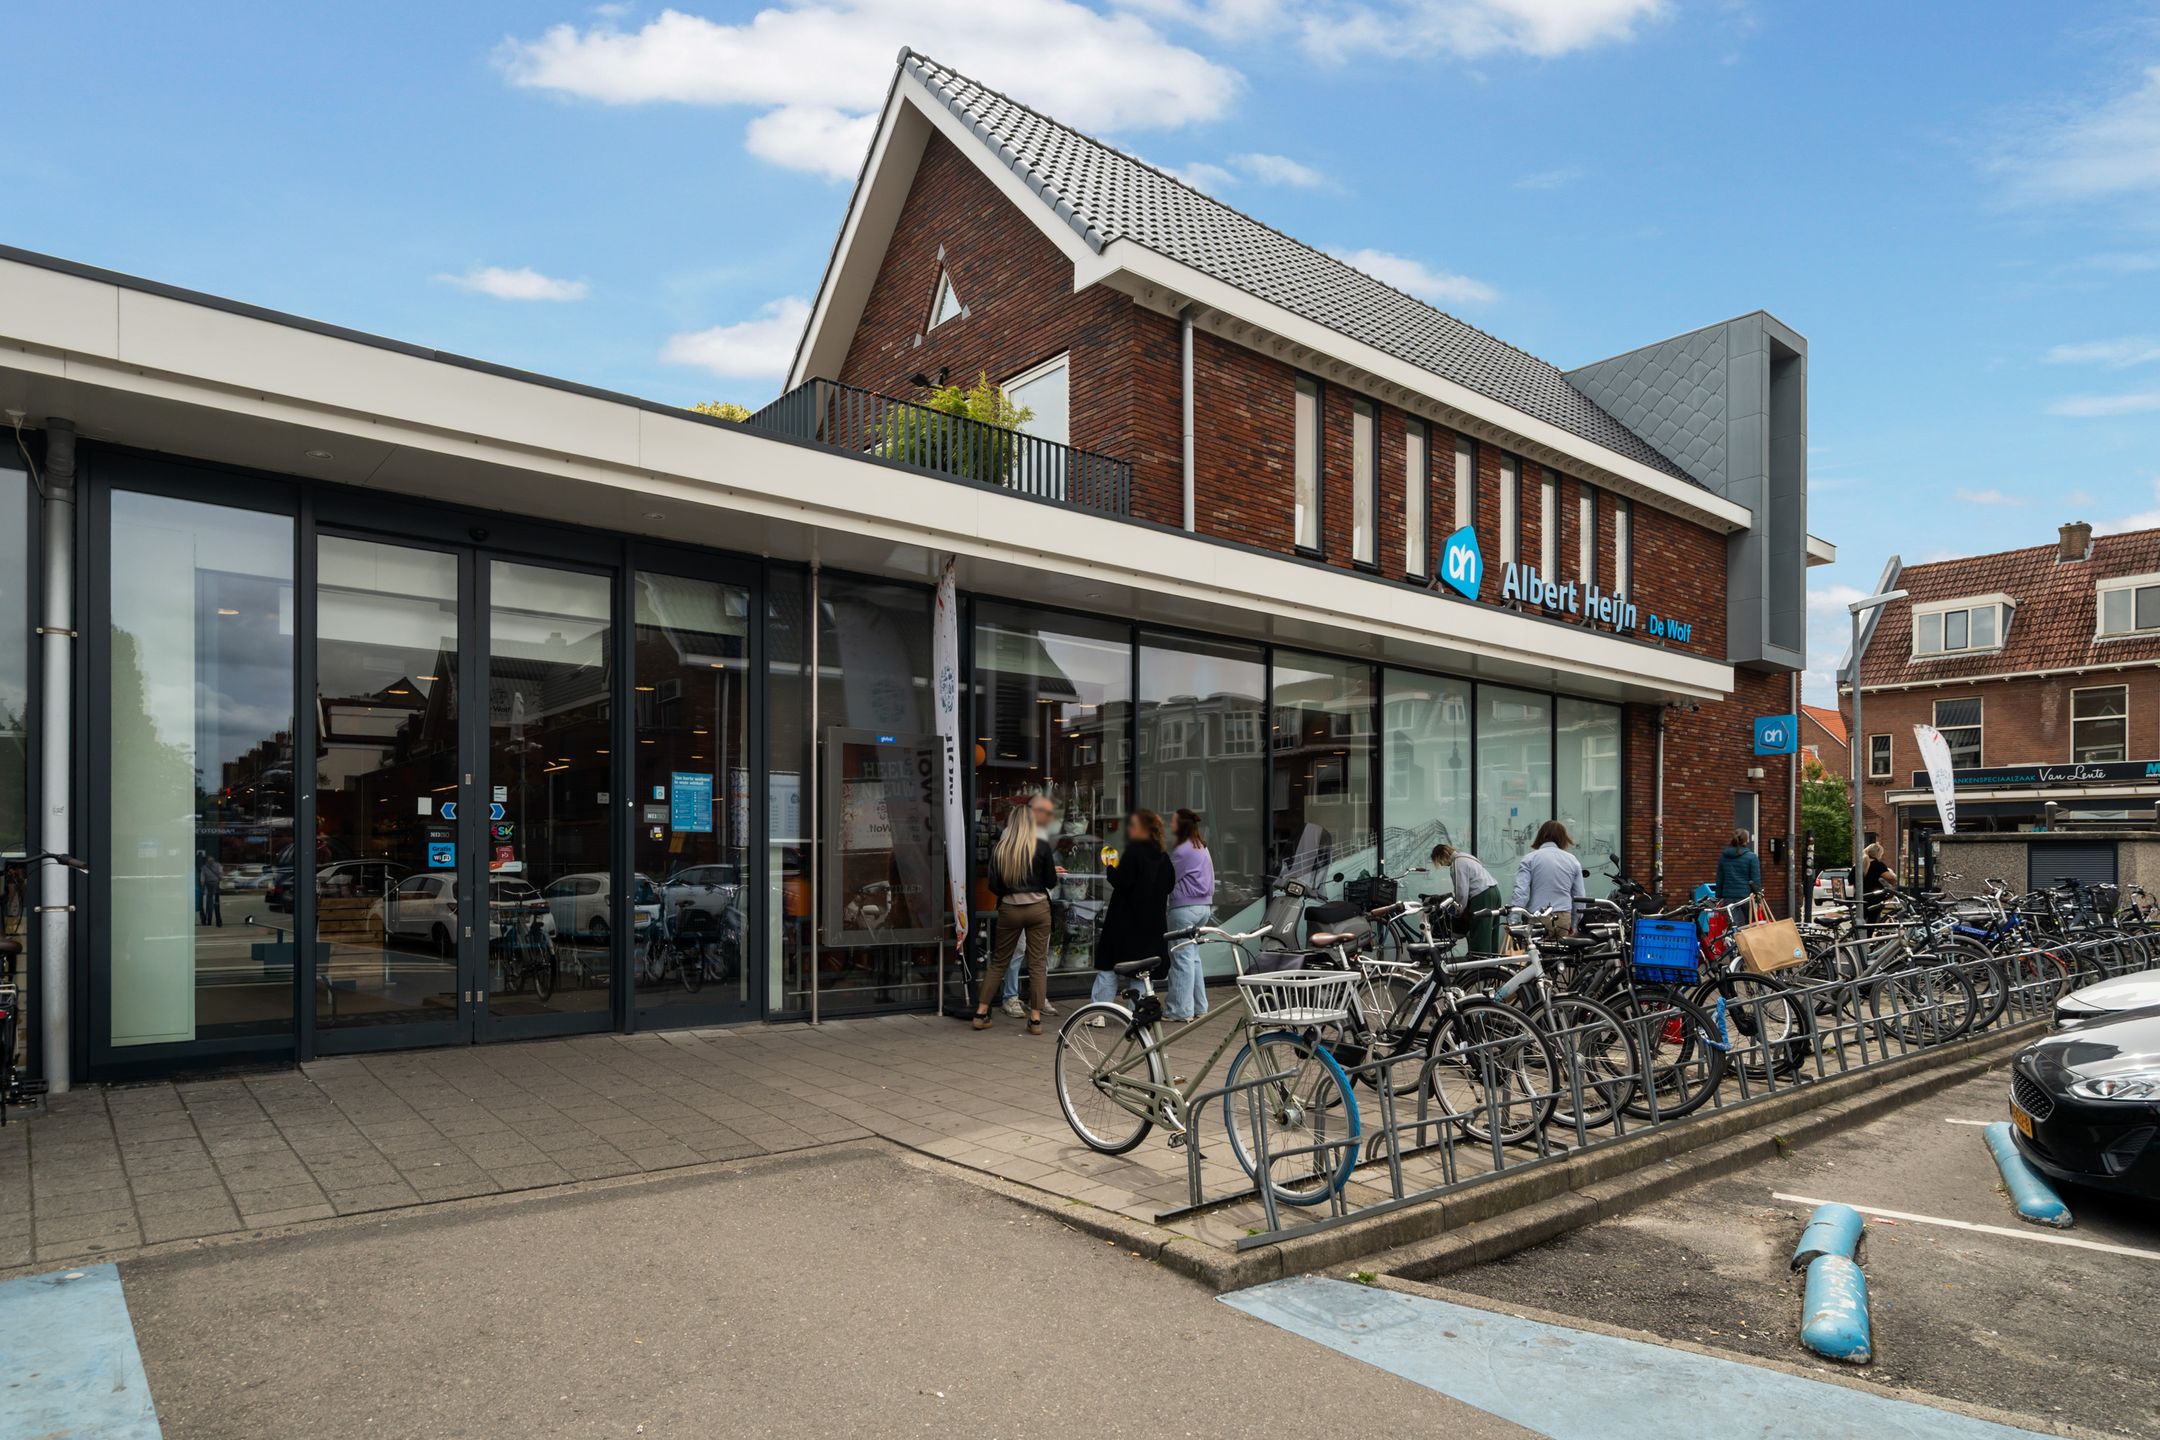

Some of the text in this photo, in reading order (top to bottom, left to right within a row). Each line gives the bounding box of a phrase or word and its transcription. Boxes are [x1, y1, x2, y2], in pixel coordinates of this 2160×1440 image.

[1503, 562, 1637, 633] Albert Heijn
[1650, 615, 1692, 643] De Wolf
[1953, 765, 2106, 784] ANKENSPECIAALZAAK Van Lente
